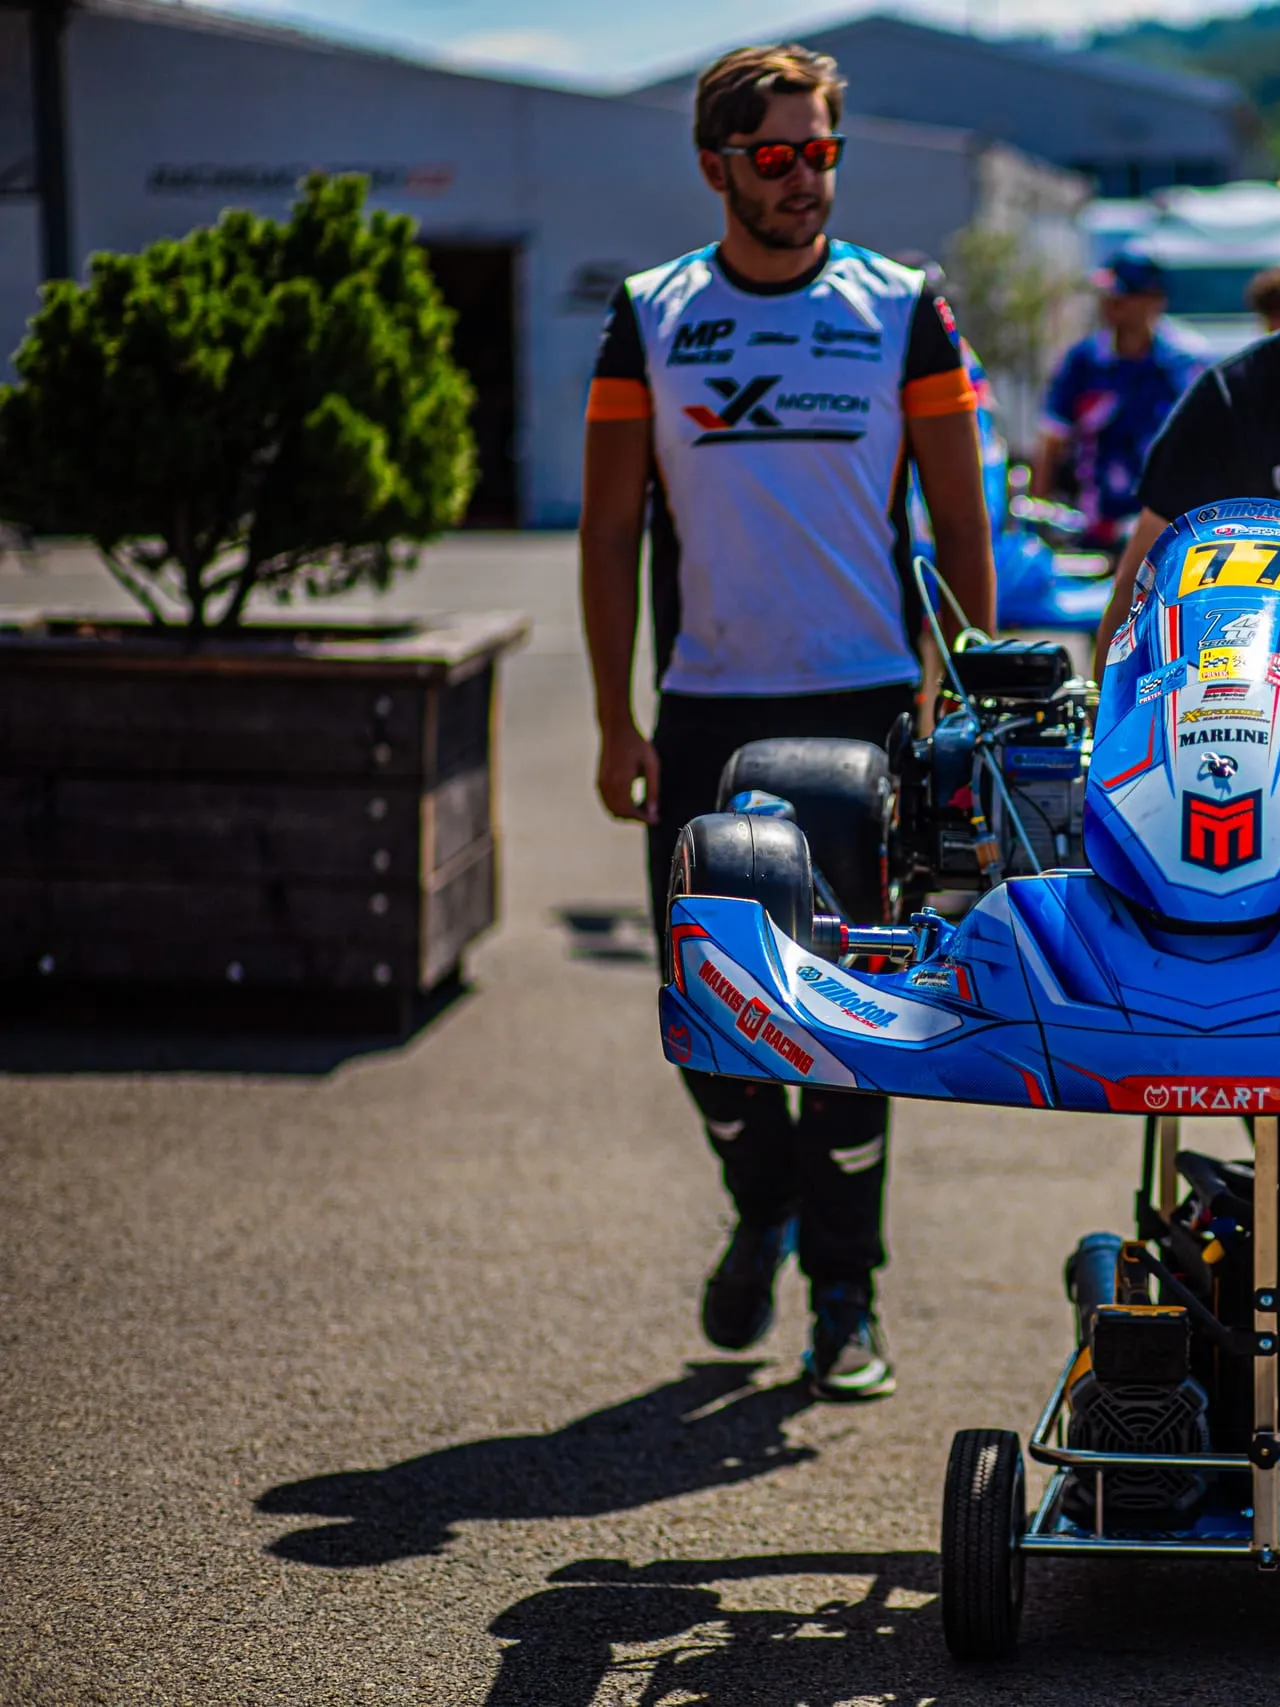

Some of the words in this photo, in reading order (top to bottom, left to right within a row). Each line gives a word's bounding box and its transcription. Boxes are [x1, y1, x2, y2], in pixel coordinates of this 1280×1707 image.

[673, 318, 736, 350] MP
[775, 393, 872, 414] MOTION
[1199, 640, 1252, 650] SERIES
[1178, 728, 1269, 748] MARLINE
[808, 976, 898, 1028] Tillotson
[698, 959, 746, 1014] MAXXIS
[761, 1022, 815, 1076] RACING
